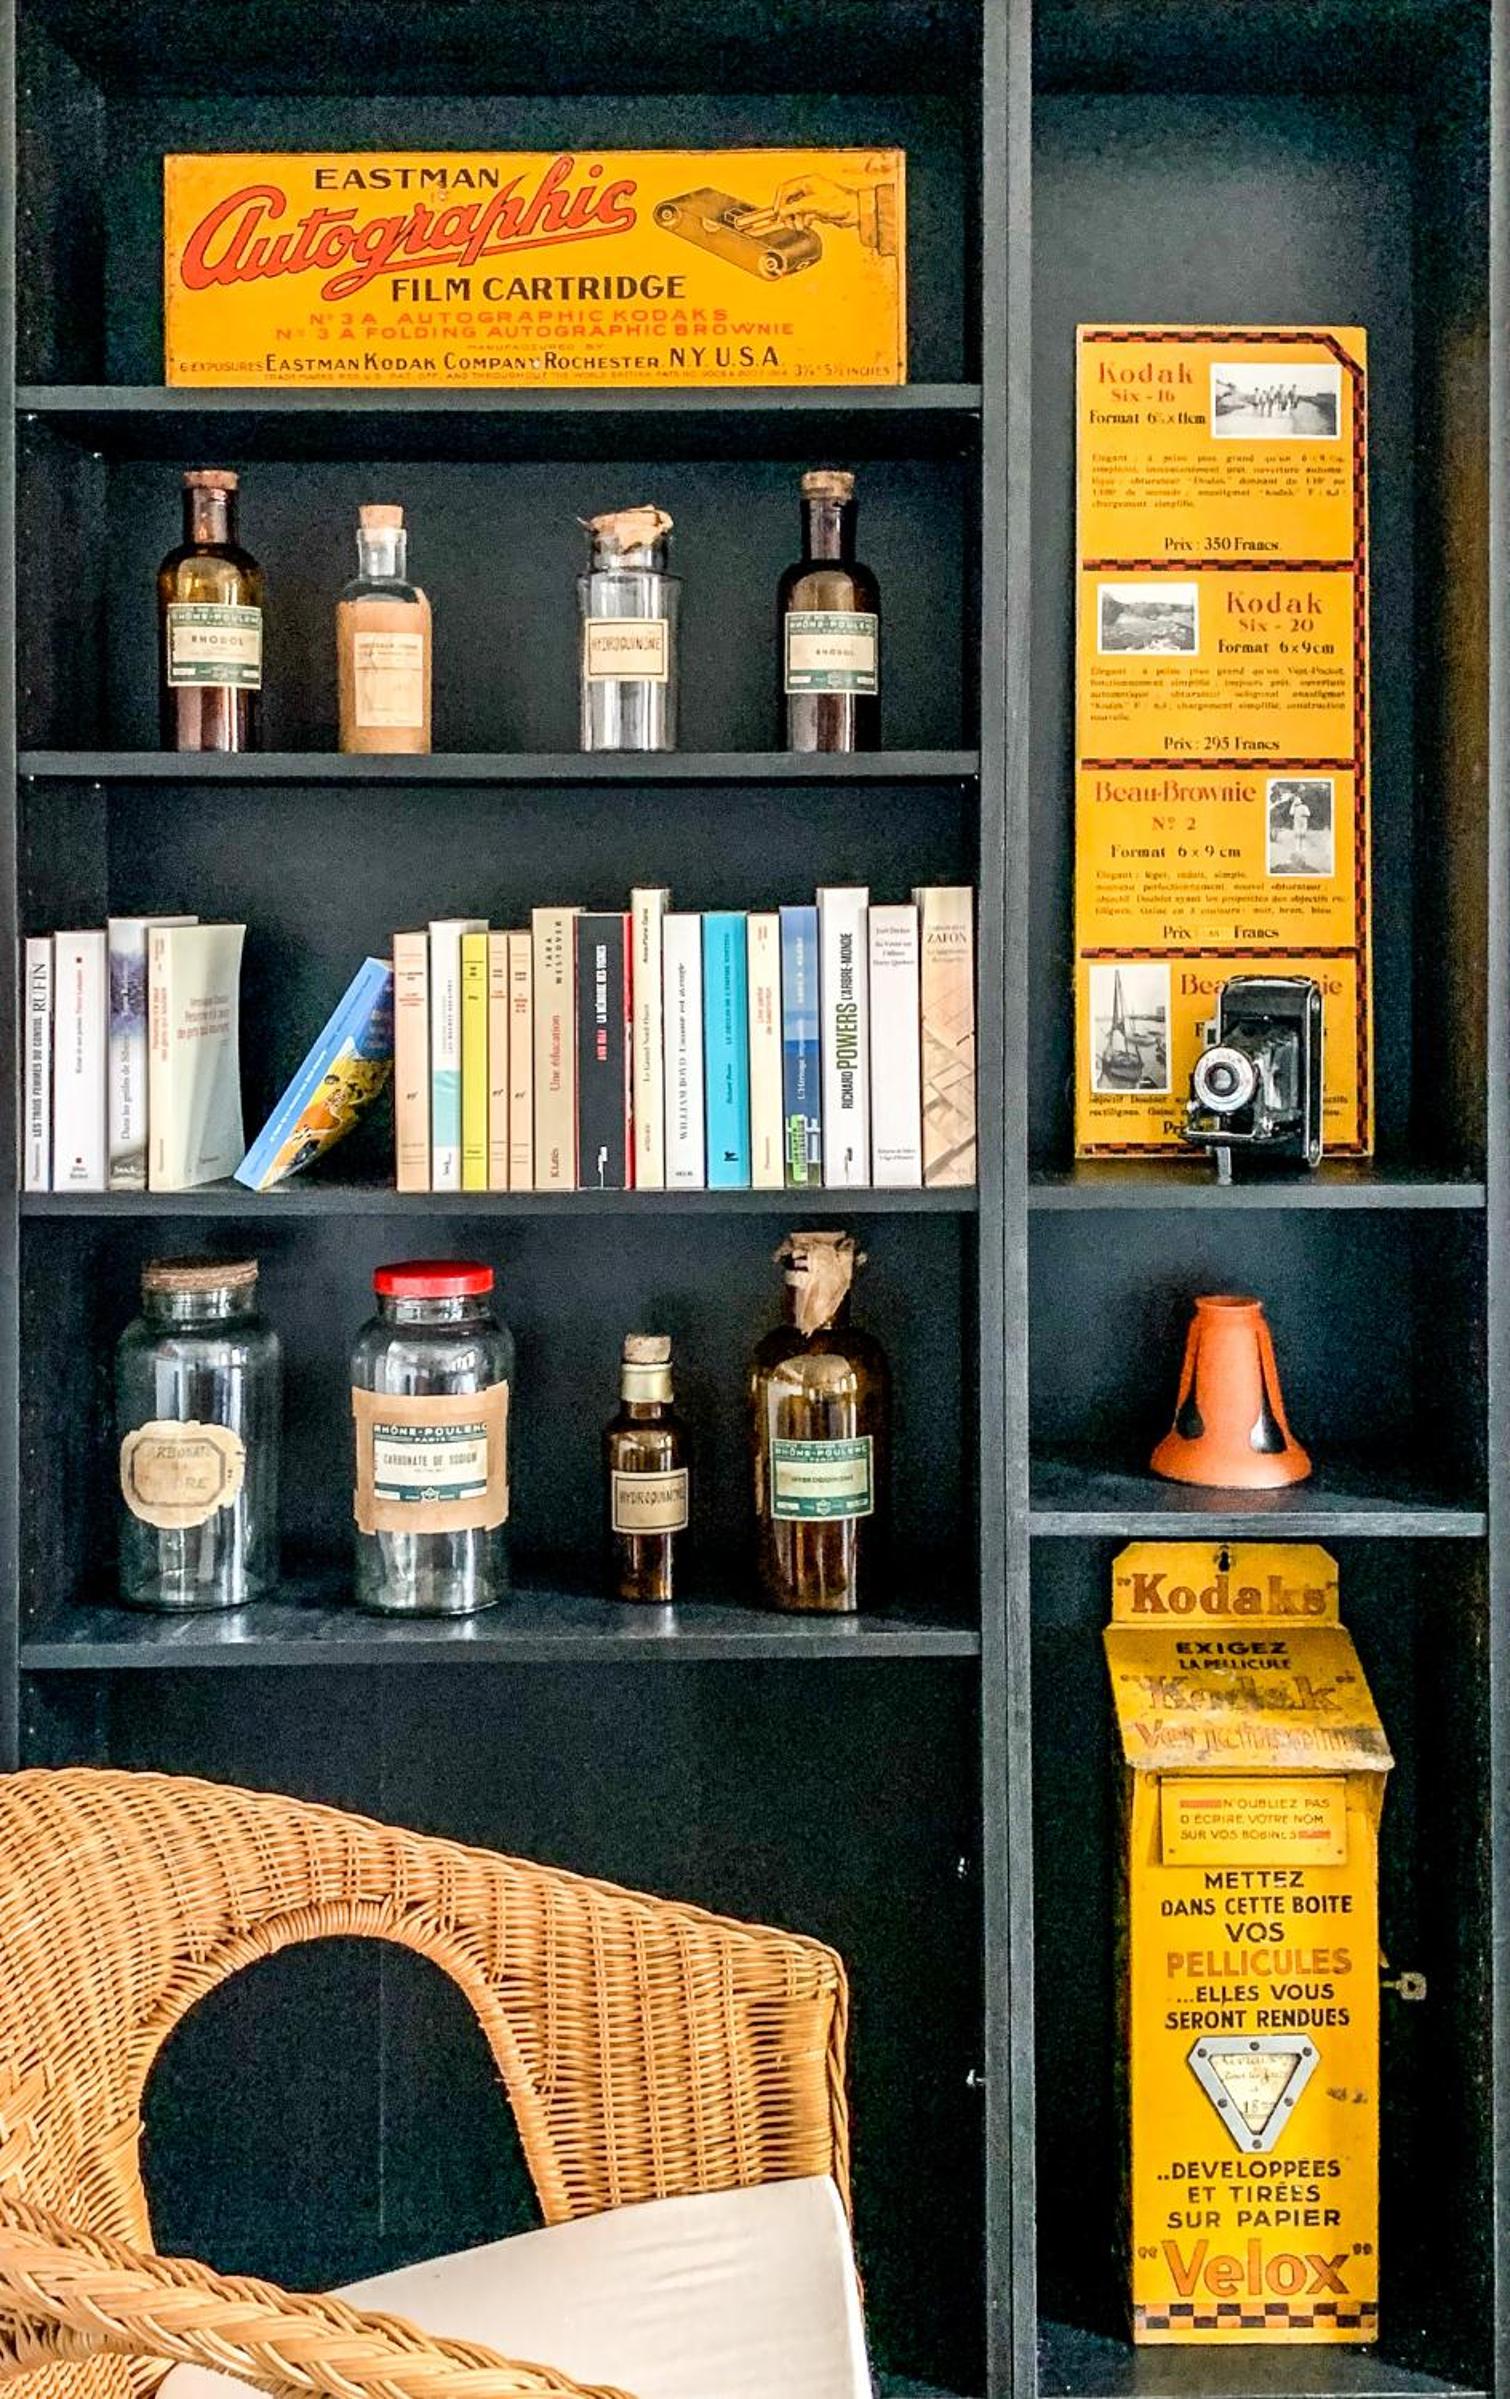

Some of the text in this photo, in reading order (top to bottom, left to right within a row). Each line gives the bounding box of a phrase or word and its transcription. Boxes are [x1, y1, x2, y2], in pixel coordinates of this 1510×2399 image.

[314, 166, 500, 191] EASTMAN
[181, 155, 637, 302] Autographic
[392, 274, 686, 302] FILM CARTRIDGE
[398, 309, 604, 325] AUTOGRAPHIC
[613, 308, 729, 322] KODAKS
[366, 325, 477, 340] FOLDING
[486, 324, 667, 339] AUTOGRAPHIC
[675, 322, 795, 337] BROWNIE
[266, 353, 360, 372] EASTMAN
[363, 352, 437, 371] KODAK
[443, 351, 541, 370] COMPANY
[1098, 361, 1194, 385] Kodak
[1089, 411, 1140, 425] Format
[1164, 536, 1195, 552] Prix
[1204, 536, 1232, 552] 350
[1227, 591, 1323, 616] Kodak
[1239, 618, 1269, 632] Six
[1290, 618, 1315, 632] 20
[1218, 640, 1270, 655] Format
[1163, 736, 1194, 751] Prix
[1203, 736, 1230, 751] 295
[1095, 779, 1258, 803] Beau-Brownie
[1110, 844, 1167, 859] Format
[1163, 925, 1193, 940] Prix
[1233, 925, 1280, 939] Francs
[32, 962, 47, 1013] RUFIN
[836, 933, 858, 1109] RICHARD POWERS L'ARBRE-MONDE
[548, 1014, 562, 1092] Une éducation
[1163, 1120, 1187, 1136] Pri
[1176, 1641, 1289, 1656] EXIGEZ
[1179, 1658, 1292, 1671] LA PELLICULE
[1303, 1798, 1331, 1809] PAS
[1247, 1813, 1290, 1824] VOTRE
[1293, 1813, 1324, 1824] NOM
[1180, 1829, 1297, 1840] SUR VOS BOBINES
[1204, 1870, 1305, 1889] METTEZ
[1161, 1894, 1353, 1917] DANS CETTE BOITE
[1225, 1921, 1285, 1944] VOS
[1165, 1946, 1353, 1979] PELLICULES
[1270, 1983, 1335, 2001] VOUS
[1164, 2006, 1350, 2030] SERONT RENDUES
[1187, 2181, 1321, 2204] ET TIRÉES
[1167, 2208, 1342, 2229] SUR PAPIER
